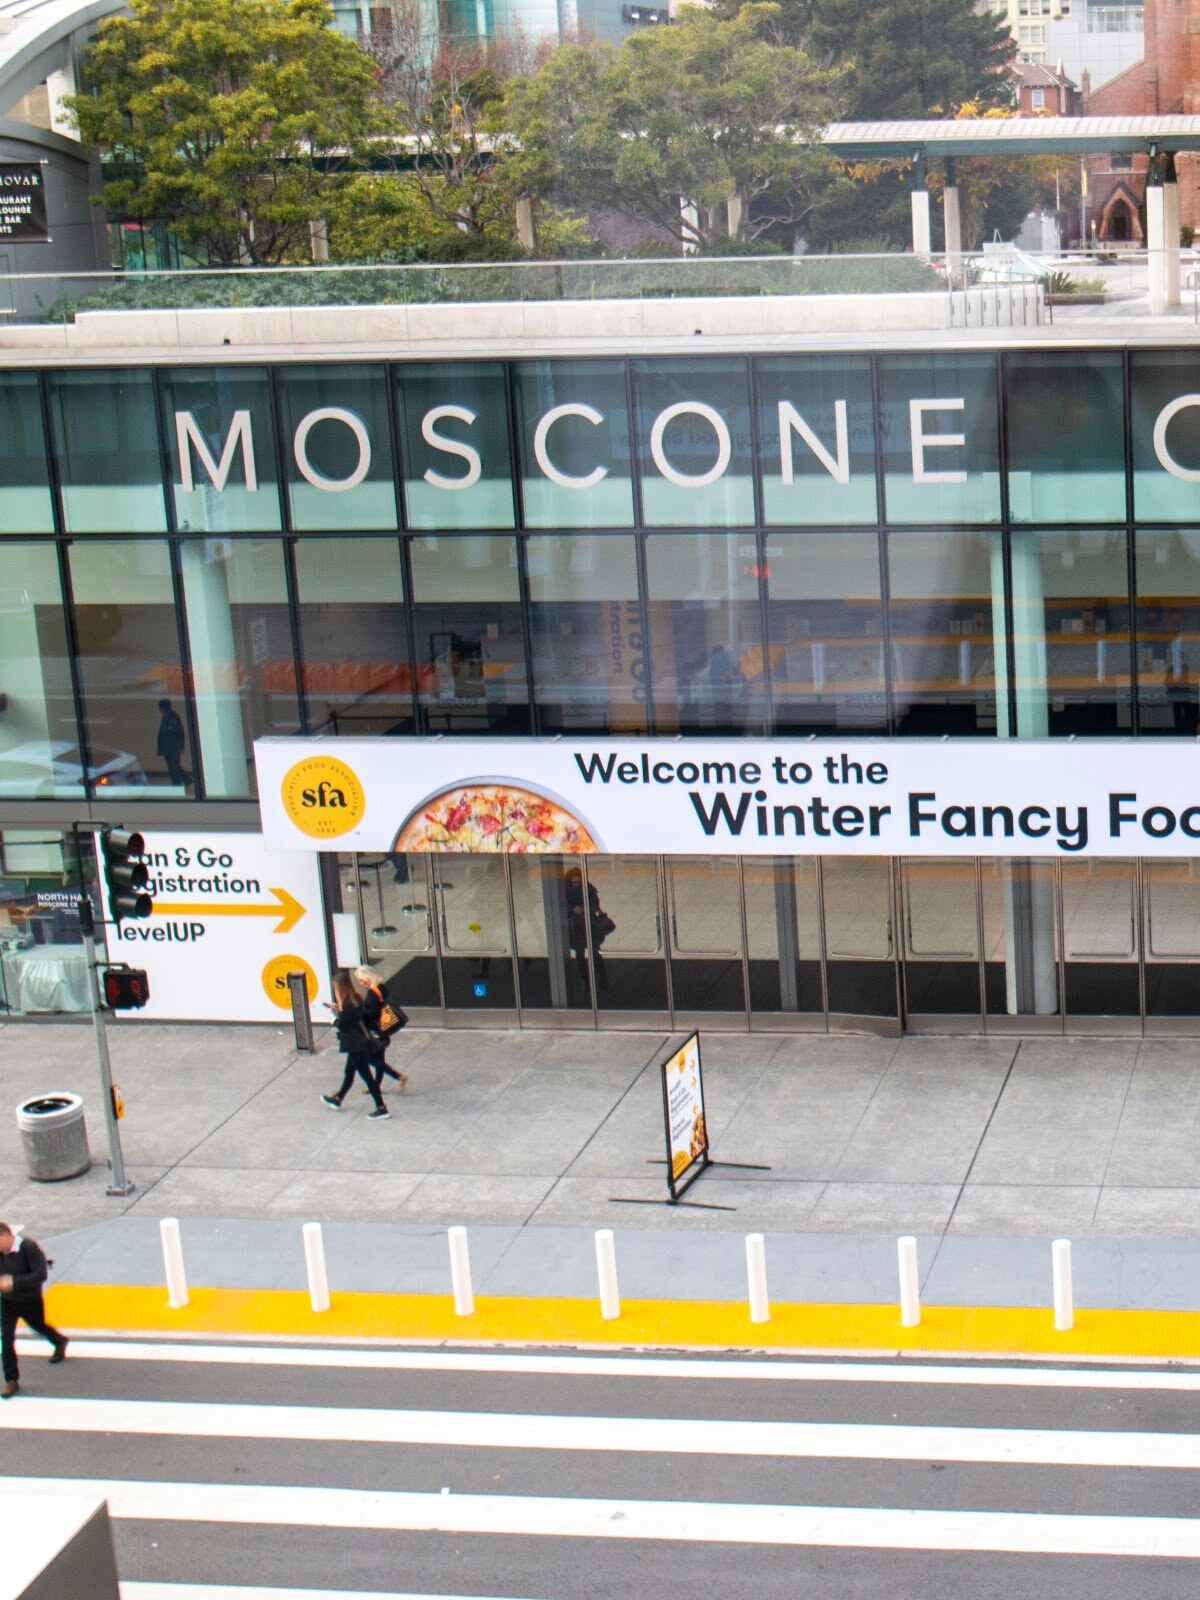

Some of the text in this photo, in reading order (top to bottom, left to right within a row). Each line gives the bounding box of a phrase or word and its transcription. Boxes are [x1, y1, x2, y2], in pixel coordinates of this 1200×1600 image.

[4, 214, 21, 223] BAR
[175, 397, 968, 492] MOSCONE
[574, 753, 889, 785] Welcome to the
[301, 781, 348, 808] sfa
[688, 790, 892, 837] Winter
[908, 792, 1088, 852] Fancy
[139, 847, 233, 868] an & Go
[37, 893, 68, 901] NORTH
[144, 871, 260, 898] gistration
